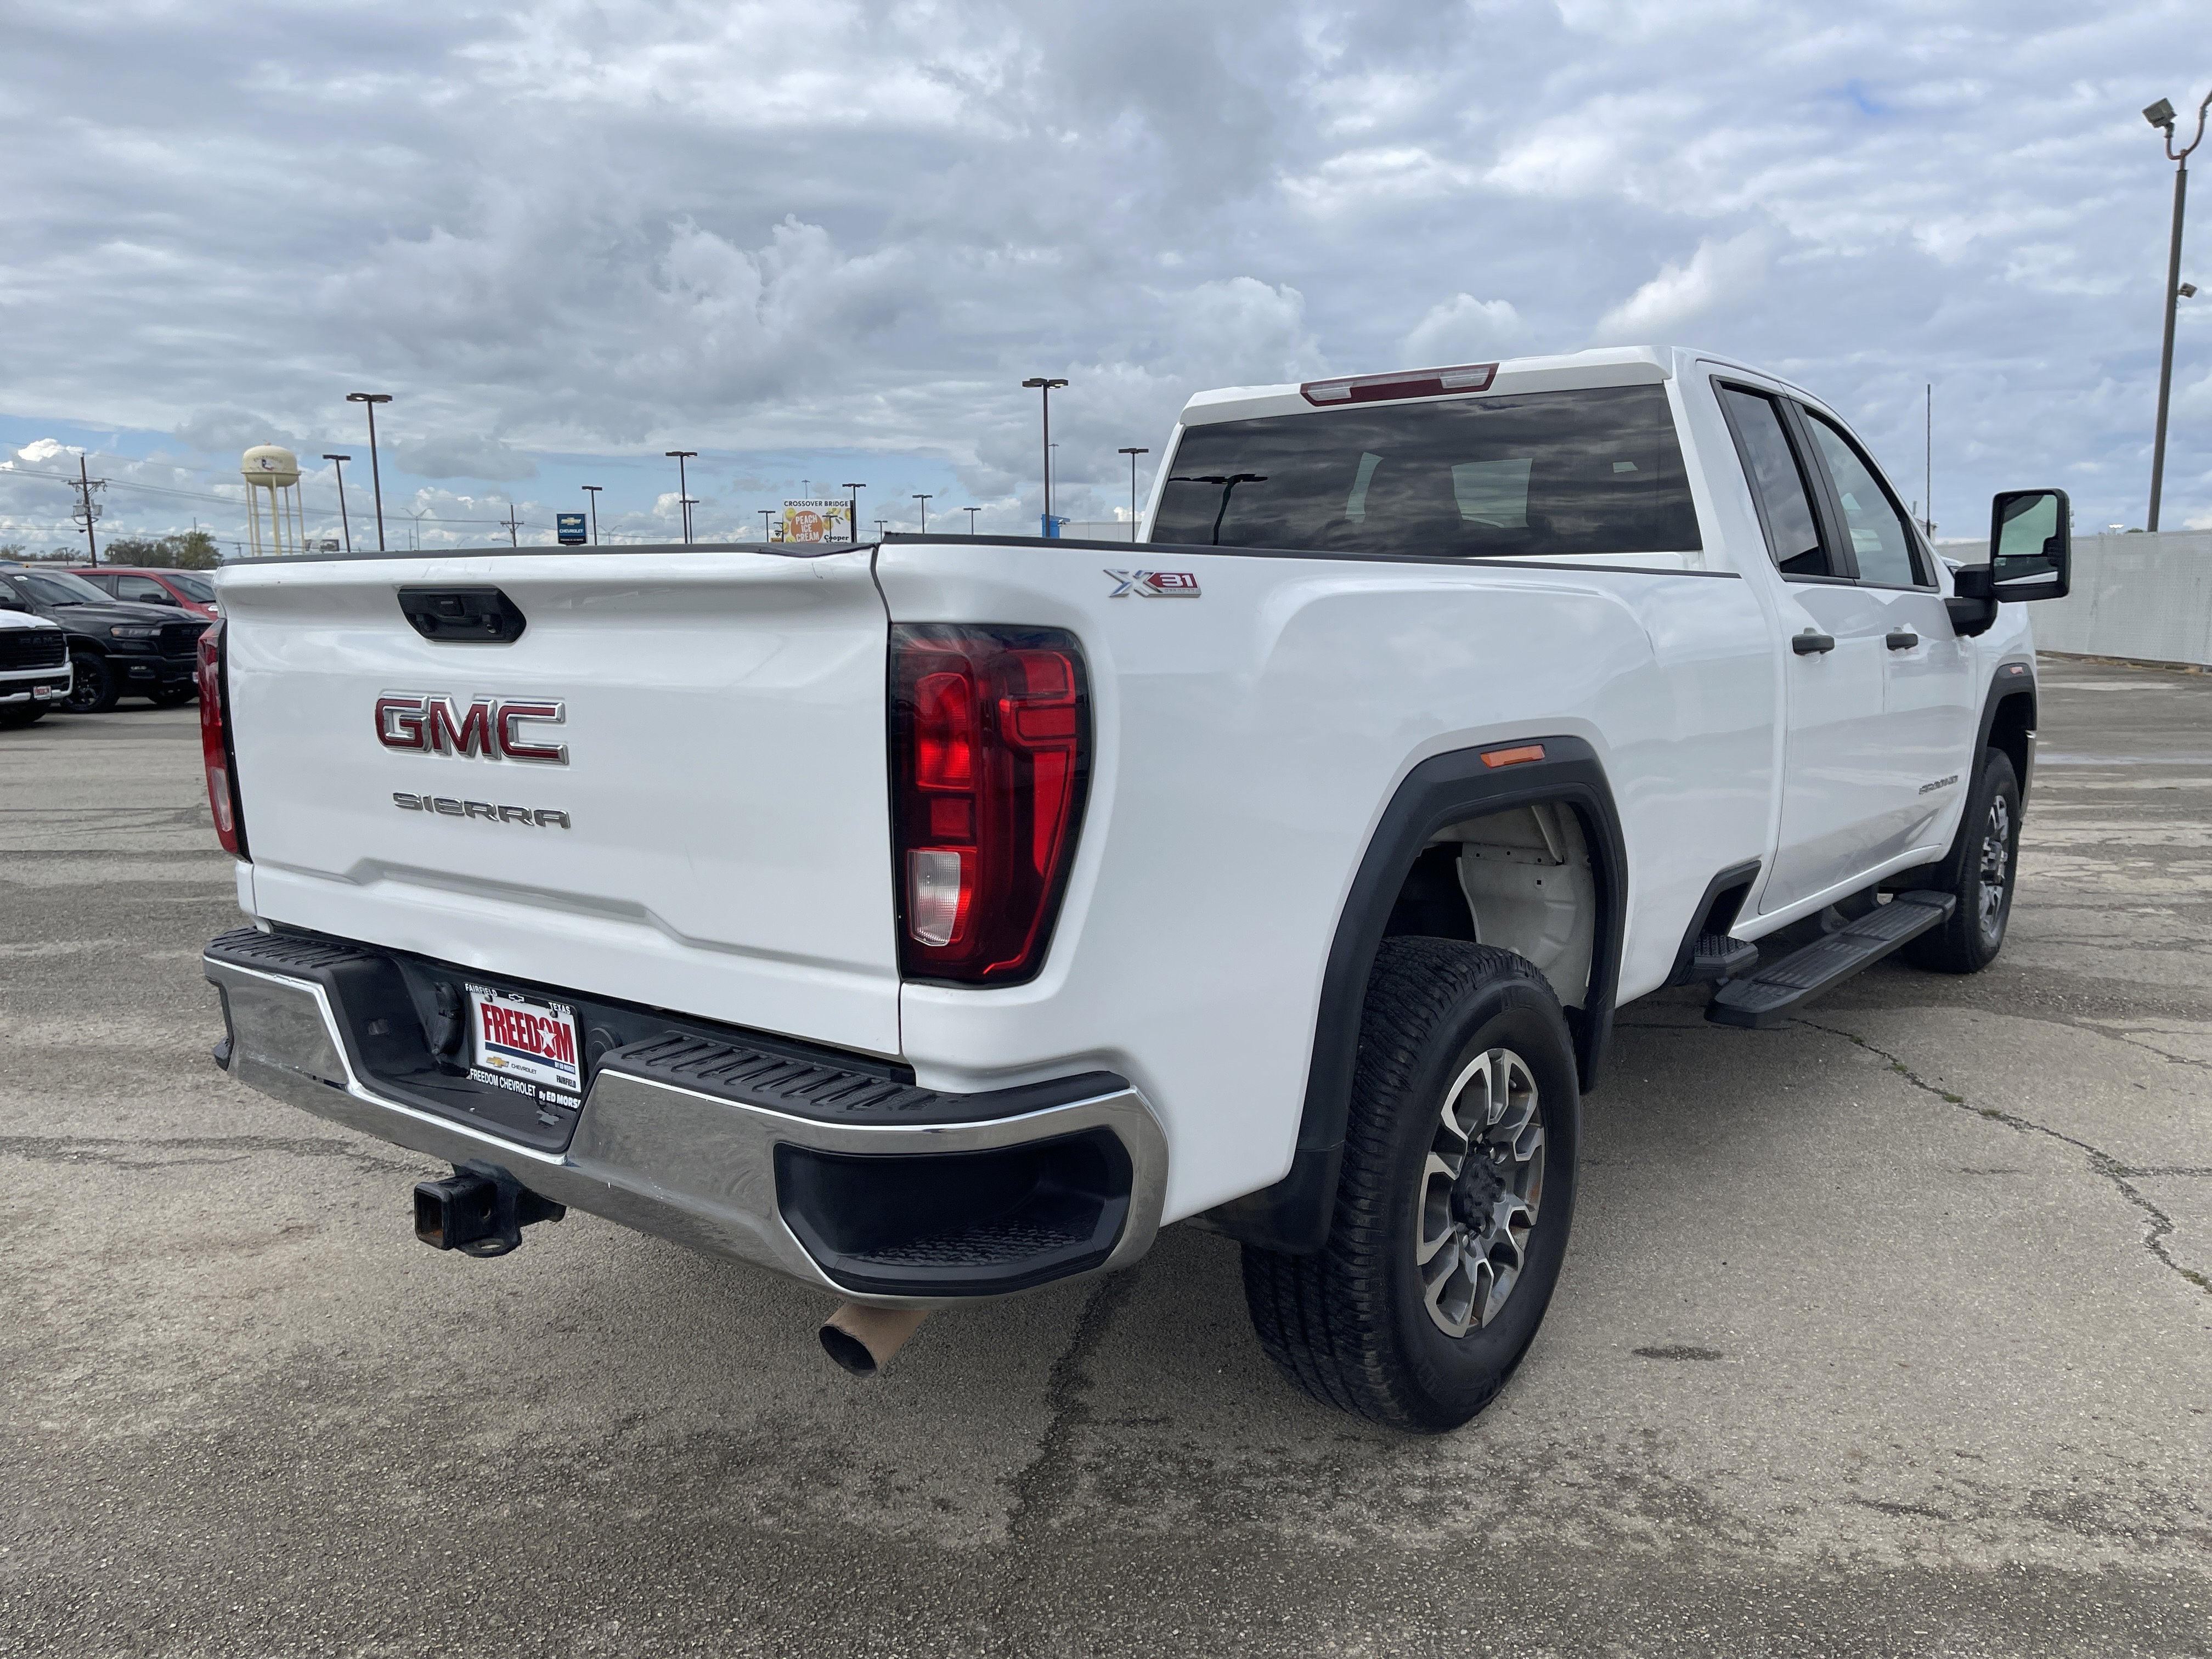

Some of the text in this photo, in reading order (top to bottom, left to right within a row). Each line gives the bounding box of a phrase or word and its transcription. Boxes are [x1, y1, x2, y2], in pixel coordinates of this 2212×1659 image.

[795, 514, 818, 525] PEACH
[801, 524, 812, 533] ICE
[796, 531, 820, 542] CREAM
[375, 695, 569, 765] GMC
[393, 792, 571, 829] SIERRA
[465, 983, 498, 997] FAIRFIELD
[549, 1001, 571, 1015] TEXAS
[480, 1002, 575, 1064] FREEDOM
[511, 1063, 537, 1075] CHEVROLET
[470, 1068, 499, 1087] FREEDOM
[499, 1076, 536, 1097] CHEVROLET
[546, 1091, 556, 1103] ED
[556, 1075, 576, 1088] FAIRFIELD
